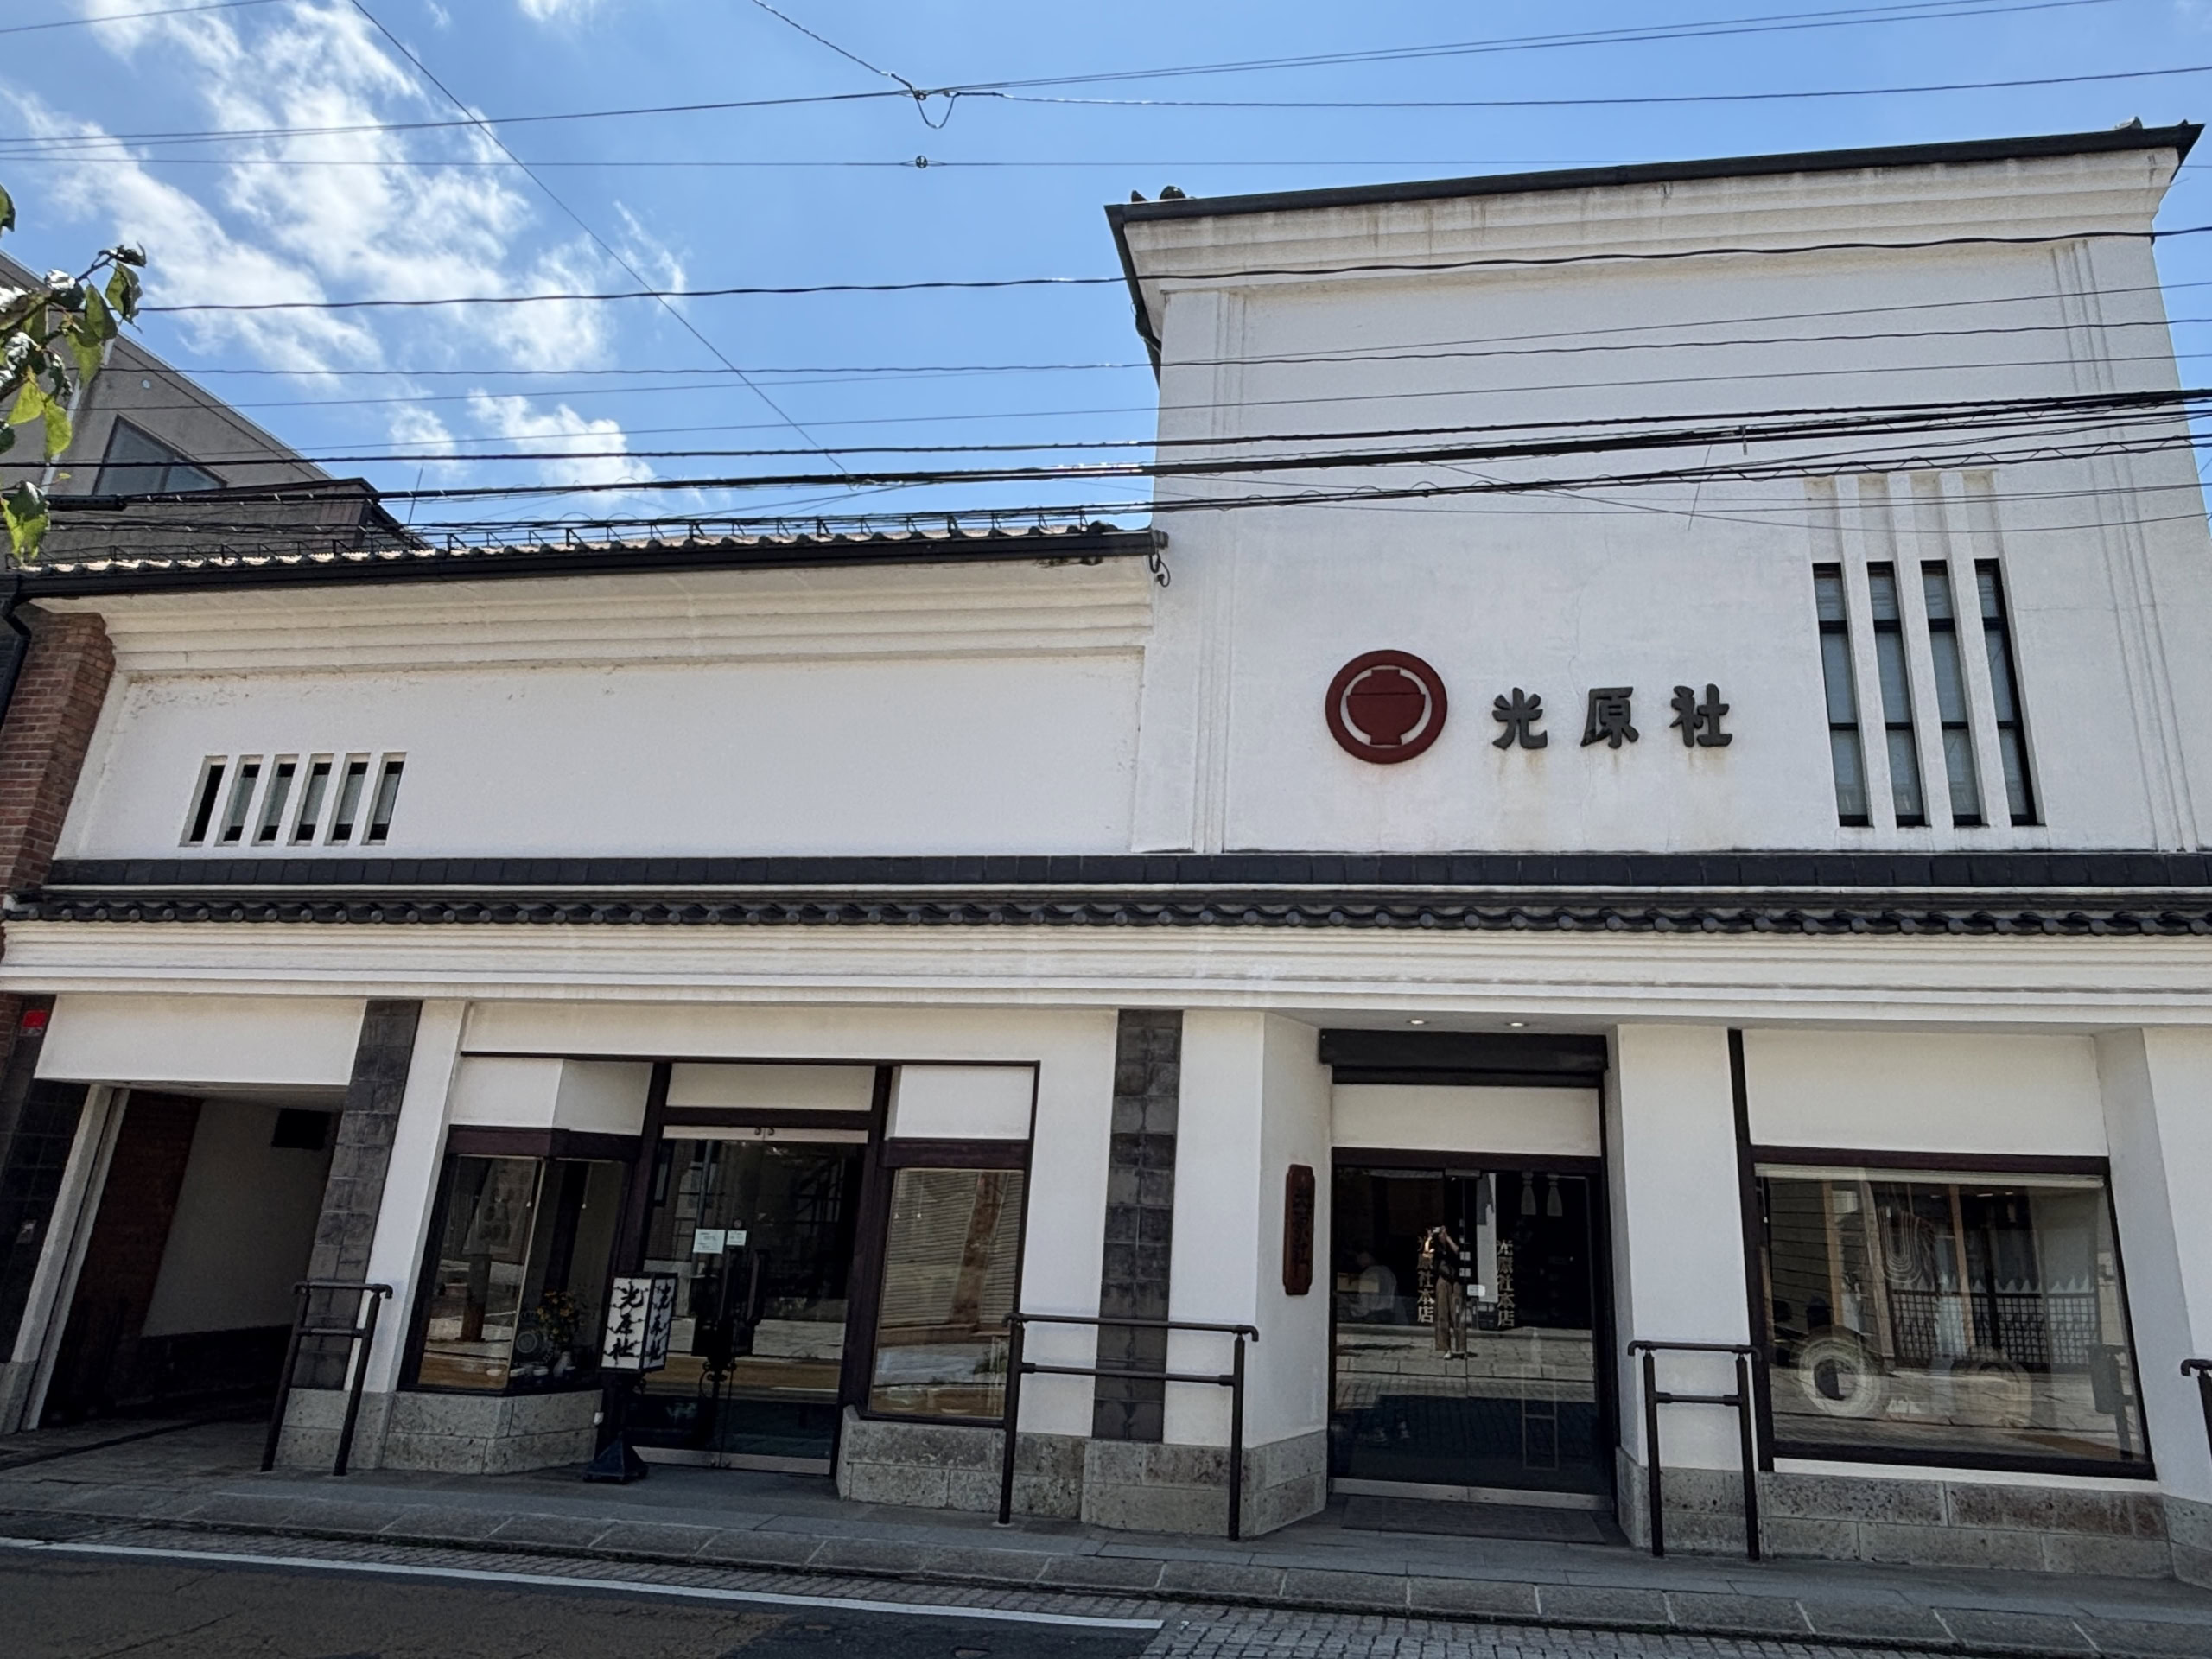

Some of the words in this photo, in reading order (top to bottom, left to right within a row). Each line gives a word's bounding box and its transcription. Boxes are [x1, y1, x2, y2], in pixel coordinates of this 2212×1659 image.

[1492, 683, 1732, 750] 光原社
[607, 1281, 647, 1365] 光原社
[1497, 1239, 1515, 1328] 光原社本店
